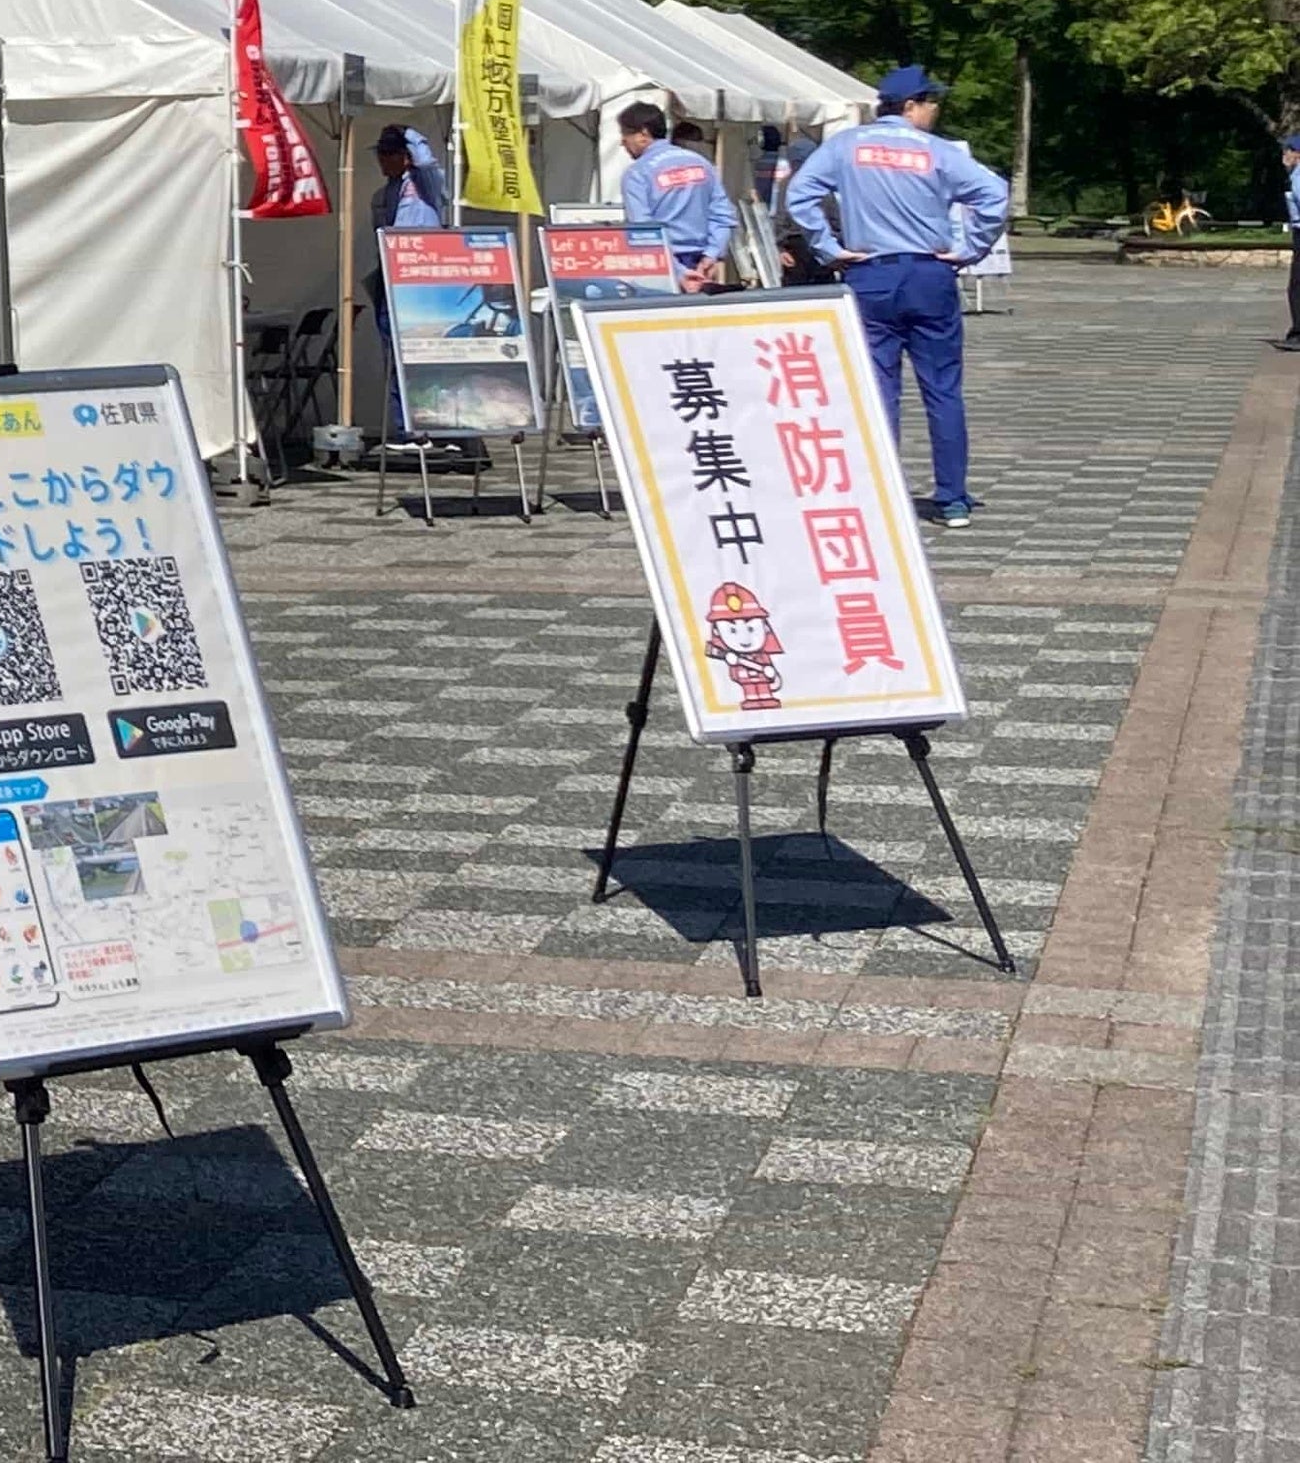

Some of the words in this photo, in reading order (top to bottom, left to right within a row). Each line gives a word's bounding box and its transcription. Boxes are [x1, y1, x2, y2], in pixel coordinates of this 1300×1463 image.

[101, 402, 160, 426] 佐賀県
[661, 357, 765, 566] 募集中
[754, 332, 905, 676] 消防団員
[27, 722, 72, 741] Store
[145, 713, 190, 735] Google
[190, 711, 216, 731] Play
